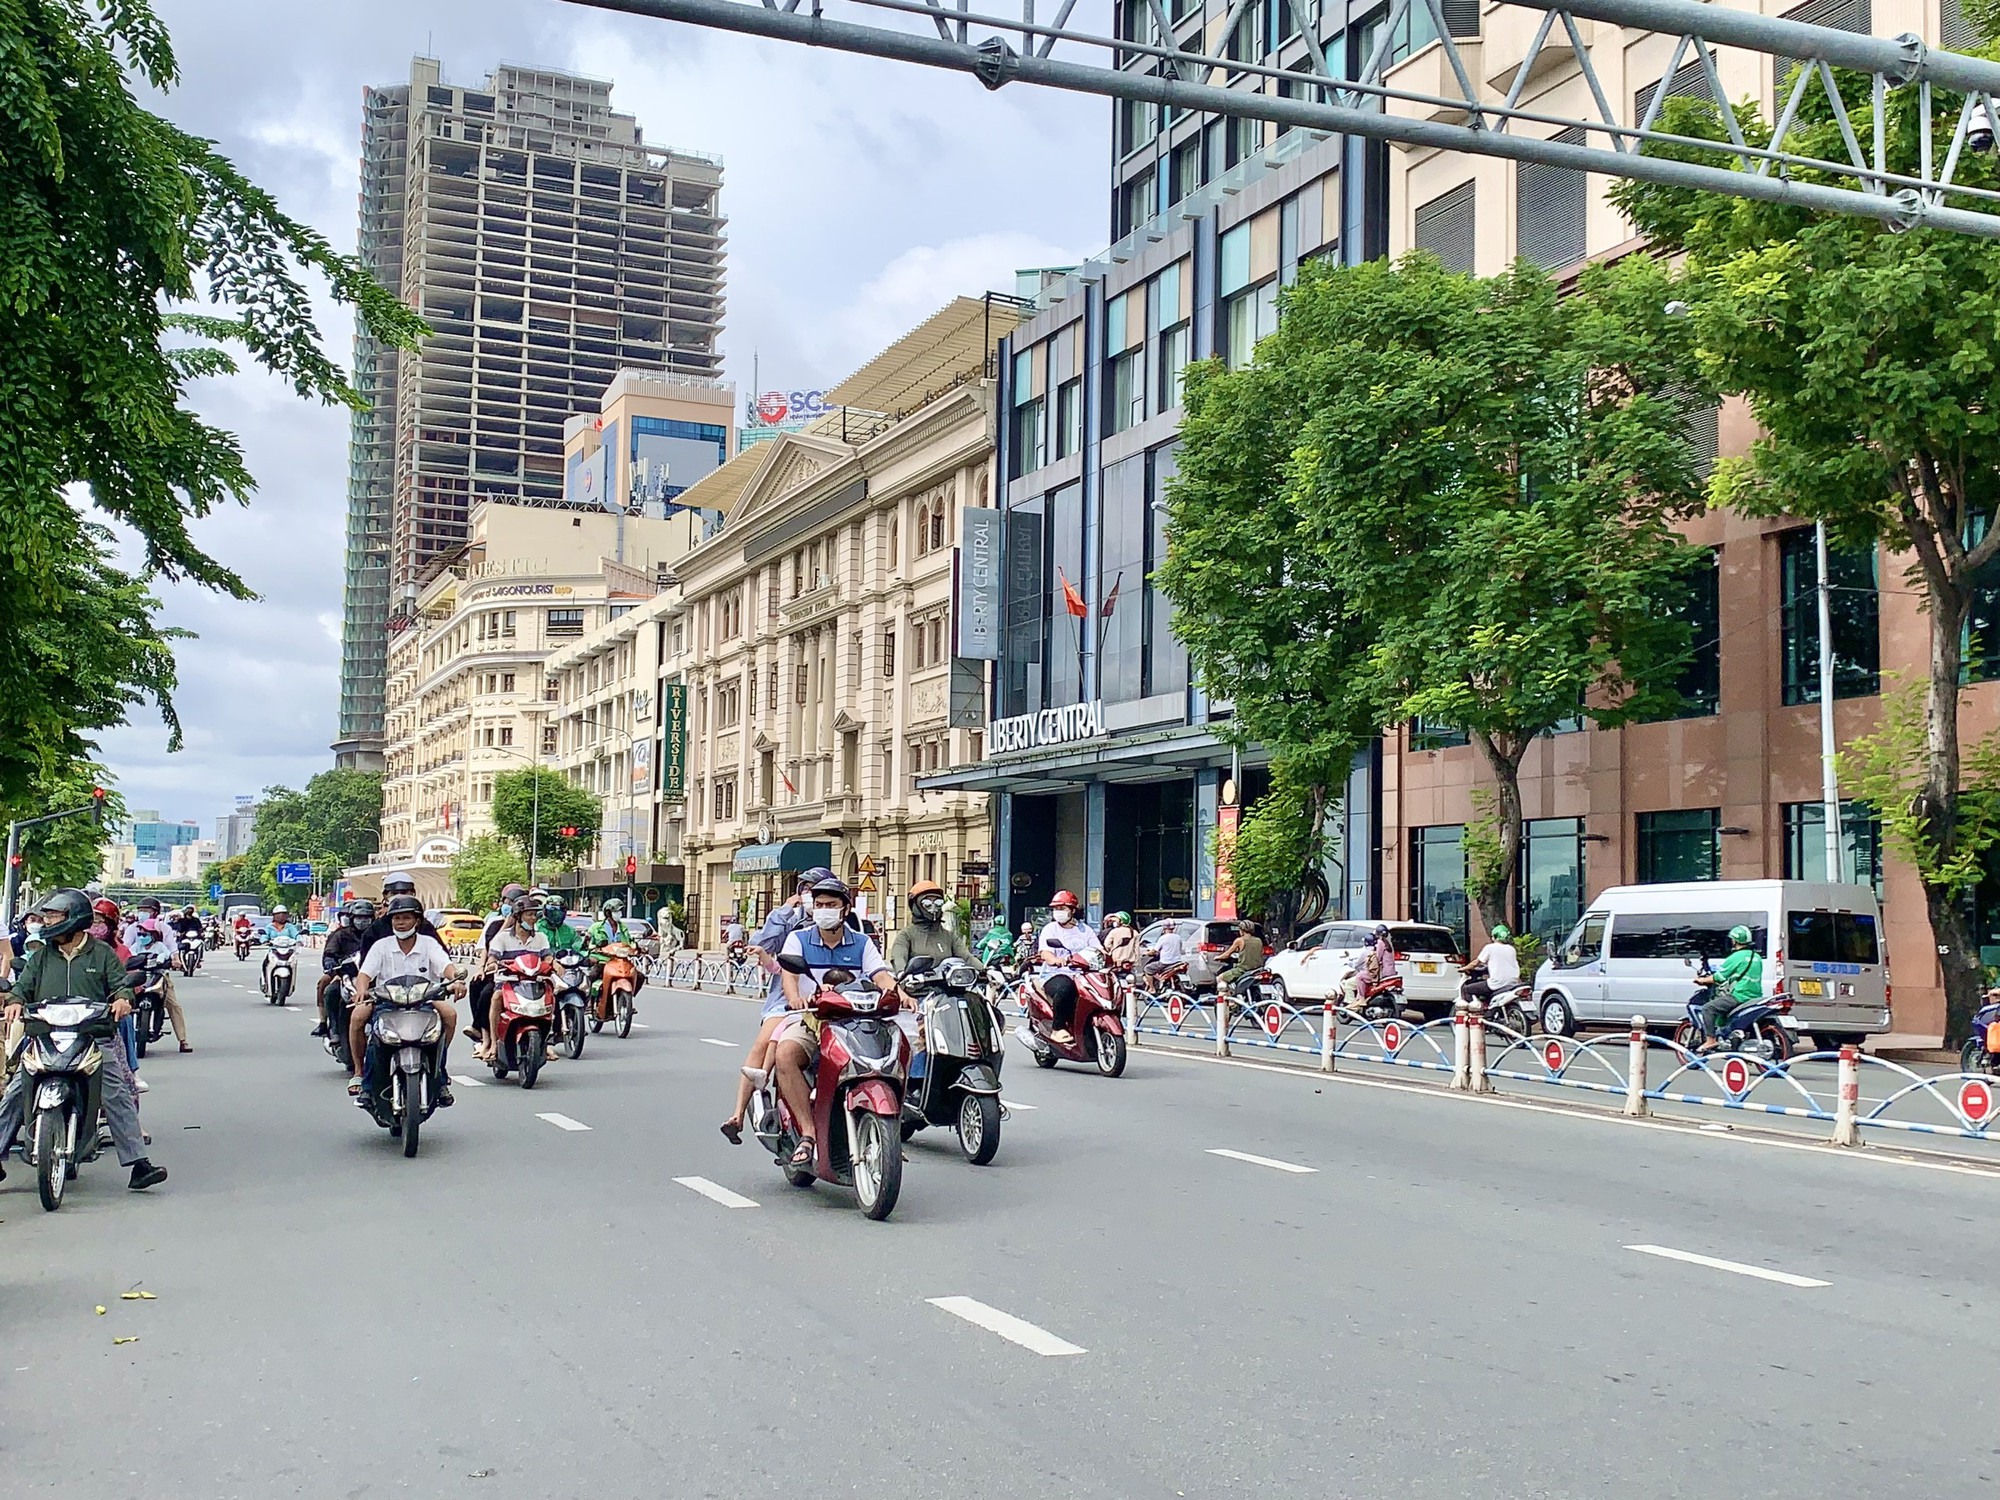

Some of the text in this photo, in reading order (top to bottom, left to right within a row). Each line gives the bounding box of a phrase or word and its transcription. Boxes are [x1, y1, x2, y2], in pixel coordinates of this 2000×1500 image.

[790, 390, 834, 412] SC
[973, 520, 990, 589] CENTRAL
[668, 686, 683, 789] RIVERSIDE
[989, 698, 1106, 754] LIBERTY CENTRAL
[916, 831, 944, 848] VENEZIA
